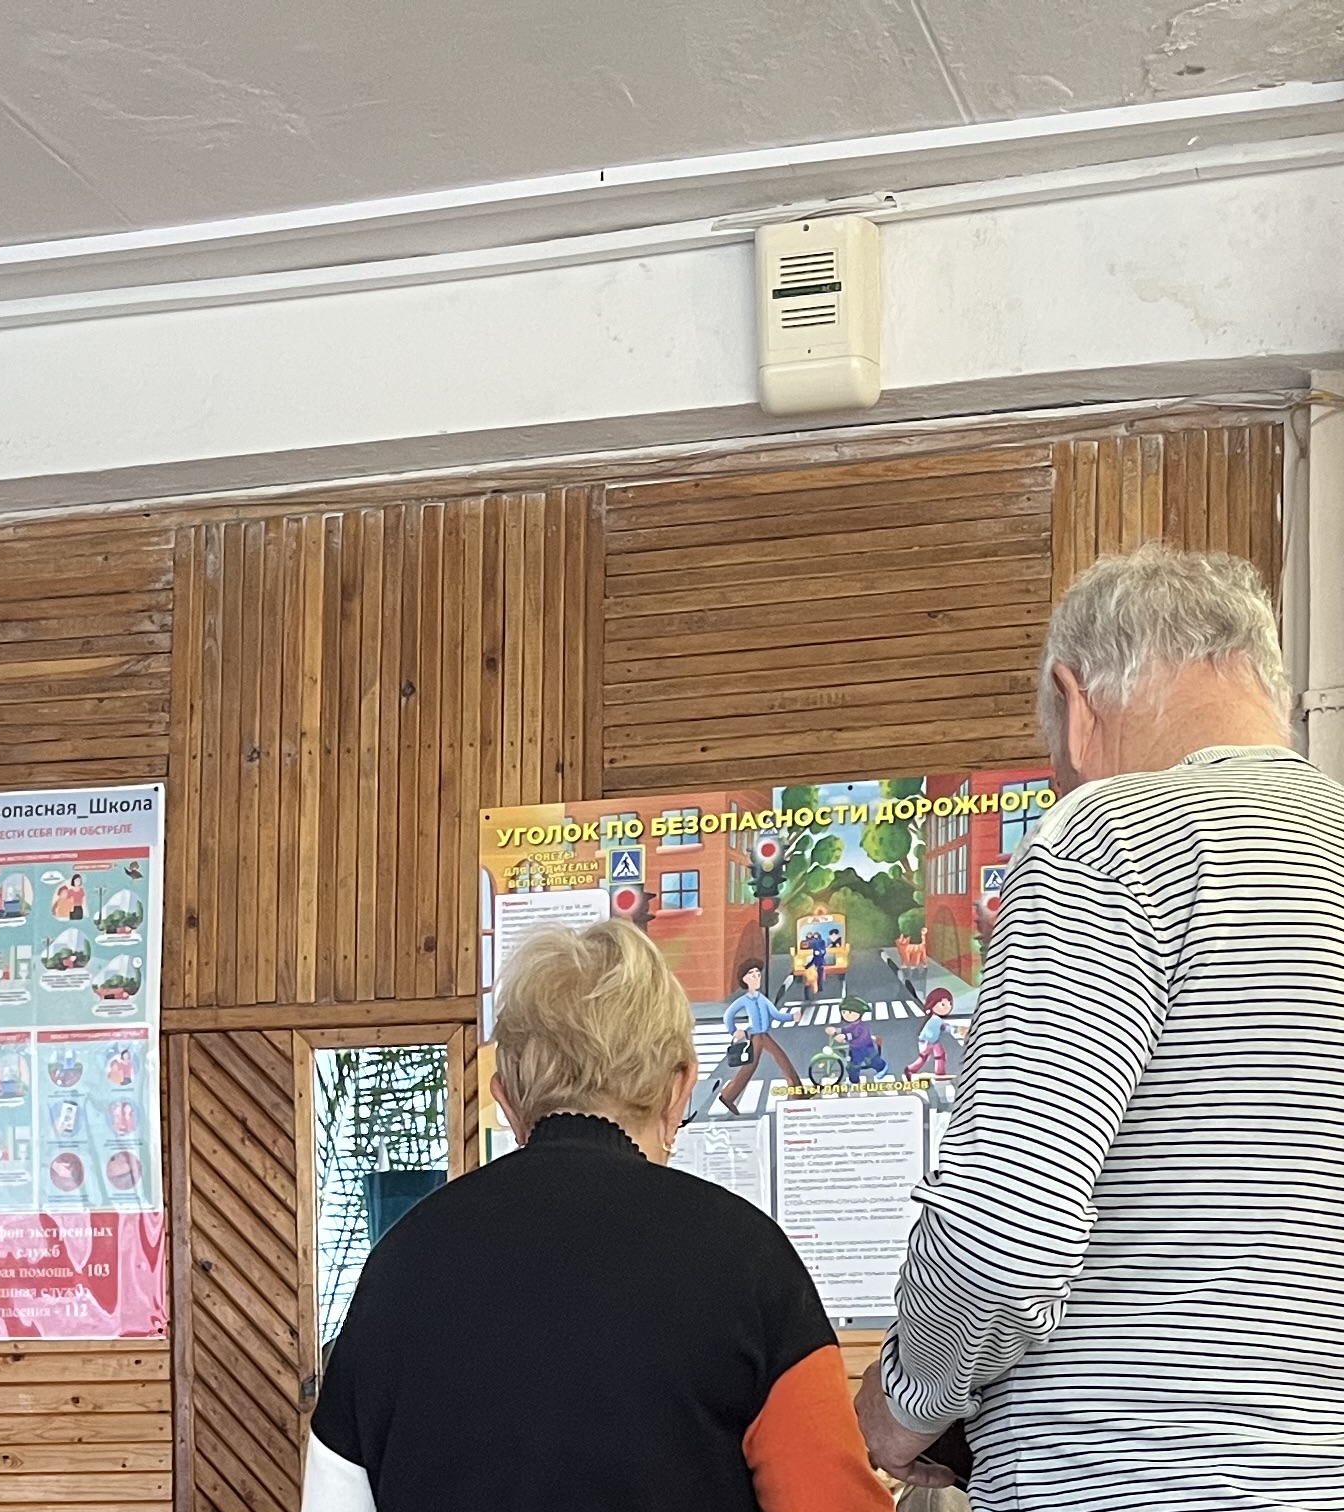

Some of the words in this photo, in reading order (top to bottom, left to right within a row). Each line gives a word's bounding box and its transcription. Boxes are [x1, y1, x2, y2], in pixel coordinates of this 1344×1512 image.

[497, 822, 600, 848] УГОЛОК
[607, 819, 643, 839] ПО
[651, 804, 869, 838] БЕЗОПАСНОСТИ
[875, 788, 1057, 825] ДОРОЖНОГО
[27, 827, 52, 839] СЕБЯ
[55, 826, 77, 837] ПРИ
[80, 823, 133, 836] ОБСТРЕЛЕ
[530, 861, 599, 874] ВОДИТЕЛЕЙ
[508, 874, 594, 889] ВЕЛОСИПЕДОВ
[29, 1225, 113, 1242] экстренных
[16, 1243, 61, 1263] служб
[19, 1266, 74, 1278] помощь
[86, 1263, 110, 1277] 103
[65, 1303, 88, 1317] 112
